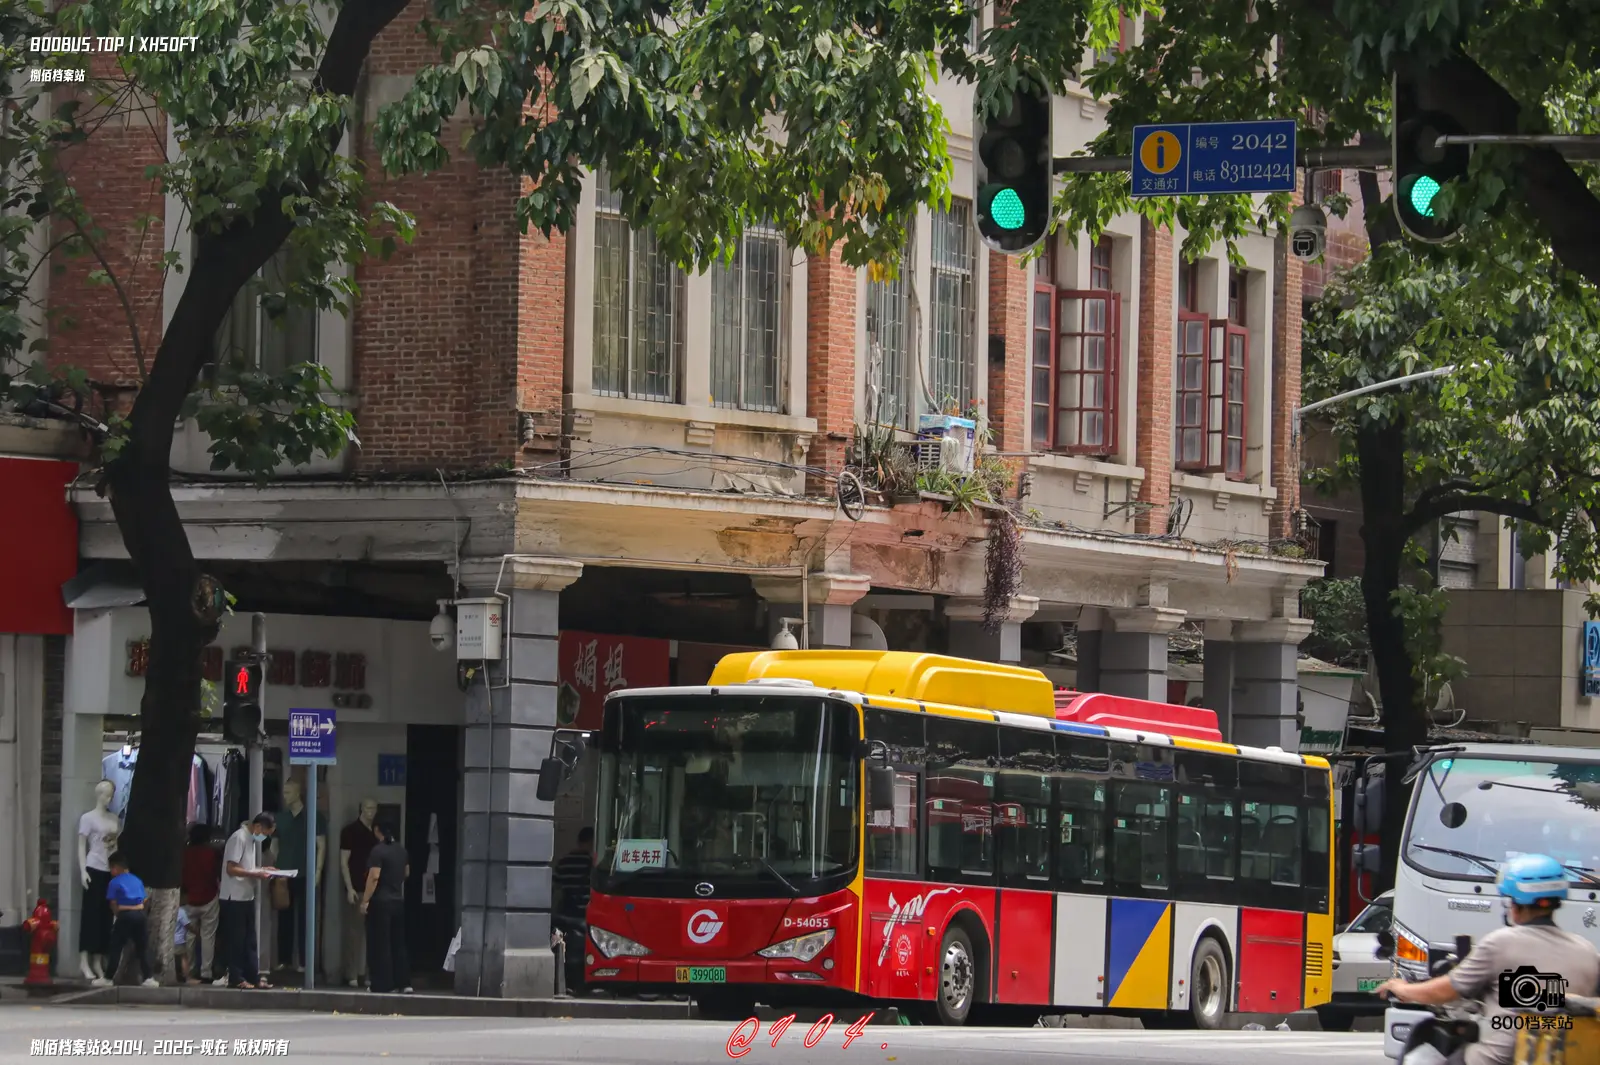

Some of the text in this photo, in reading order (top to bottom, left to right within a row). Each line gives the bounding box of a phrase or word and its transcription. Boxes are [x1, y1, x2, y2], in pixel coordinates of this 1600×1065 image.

[1195, 133, 1288, 154] 编号 2042
[1193, 160, 1291, 183] 电话 83112424
[1141, 177, 1179, 191] 交通灯
[621, 847, 661, 864] 此车先开
[784, 917, 829, 928] D-54055
